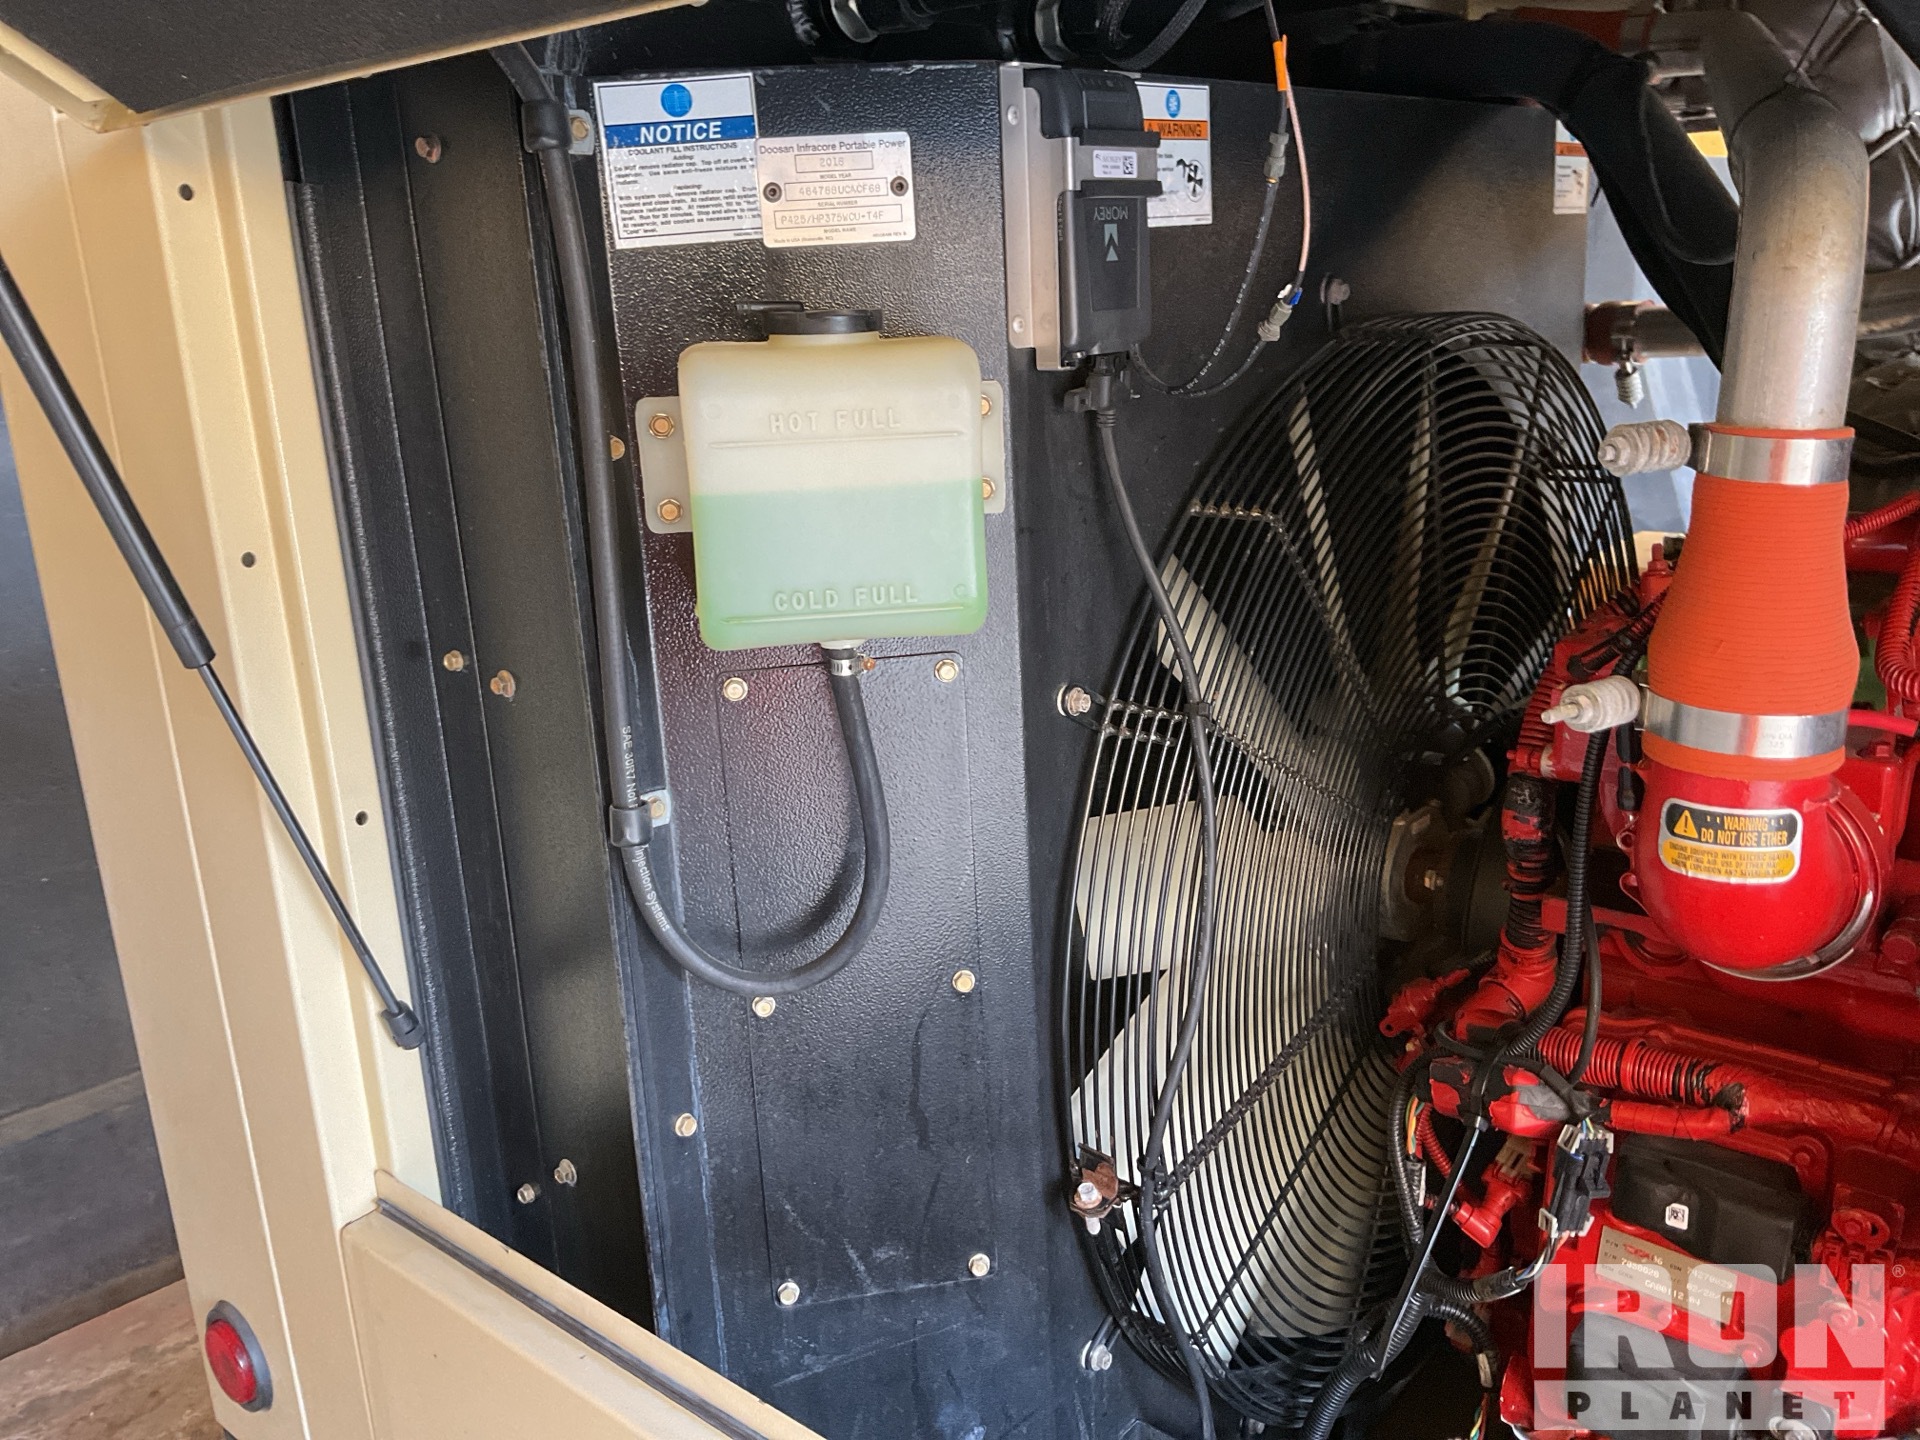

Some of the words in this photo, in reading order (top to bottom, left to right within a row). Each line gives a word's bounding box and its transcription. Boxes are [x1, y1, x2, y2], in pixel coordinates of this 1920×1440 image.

[640, 121, 722, 144] NOTICE
[1158, 122, 1203, 138] WARNING
[628, 147, 664, 156] COOLANT
[666, 146, 681, 154] FILL
[683, 142, 737, 151] INSTRUCTIONS
[759, 145, 794, 155] Doosan
[796, 142, 837, 152] Infracore
[839, 140, 876, 151] Portable
[878, 139, 906, 149] Power
[1093, 206, 1129, 220] MOREY
[769, 411, 819, 434] HOT
[834, 408, 902, 430] FULL
[774, 589, 839, 611] COLD
[854, 585, 918, 607] FULL
[622, 726, 633, 750] SAE
[624, 751, 636, 779] 30R7
[1724, 815, 1769, 832] WARNING
[1700, 828, 1714, 843] DO
[1717, 829, 1737, 846] NOT
[1739, 831, 1758, 847] USE
[1760, 830, 1788, 846] ETHER
[645, 890, 671, 932] Systems
